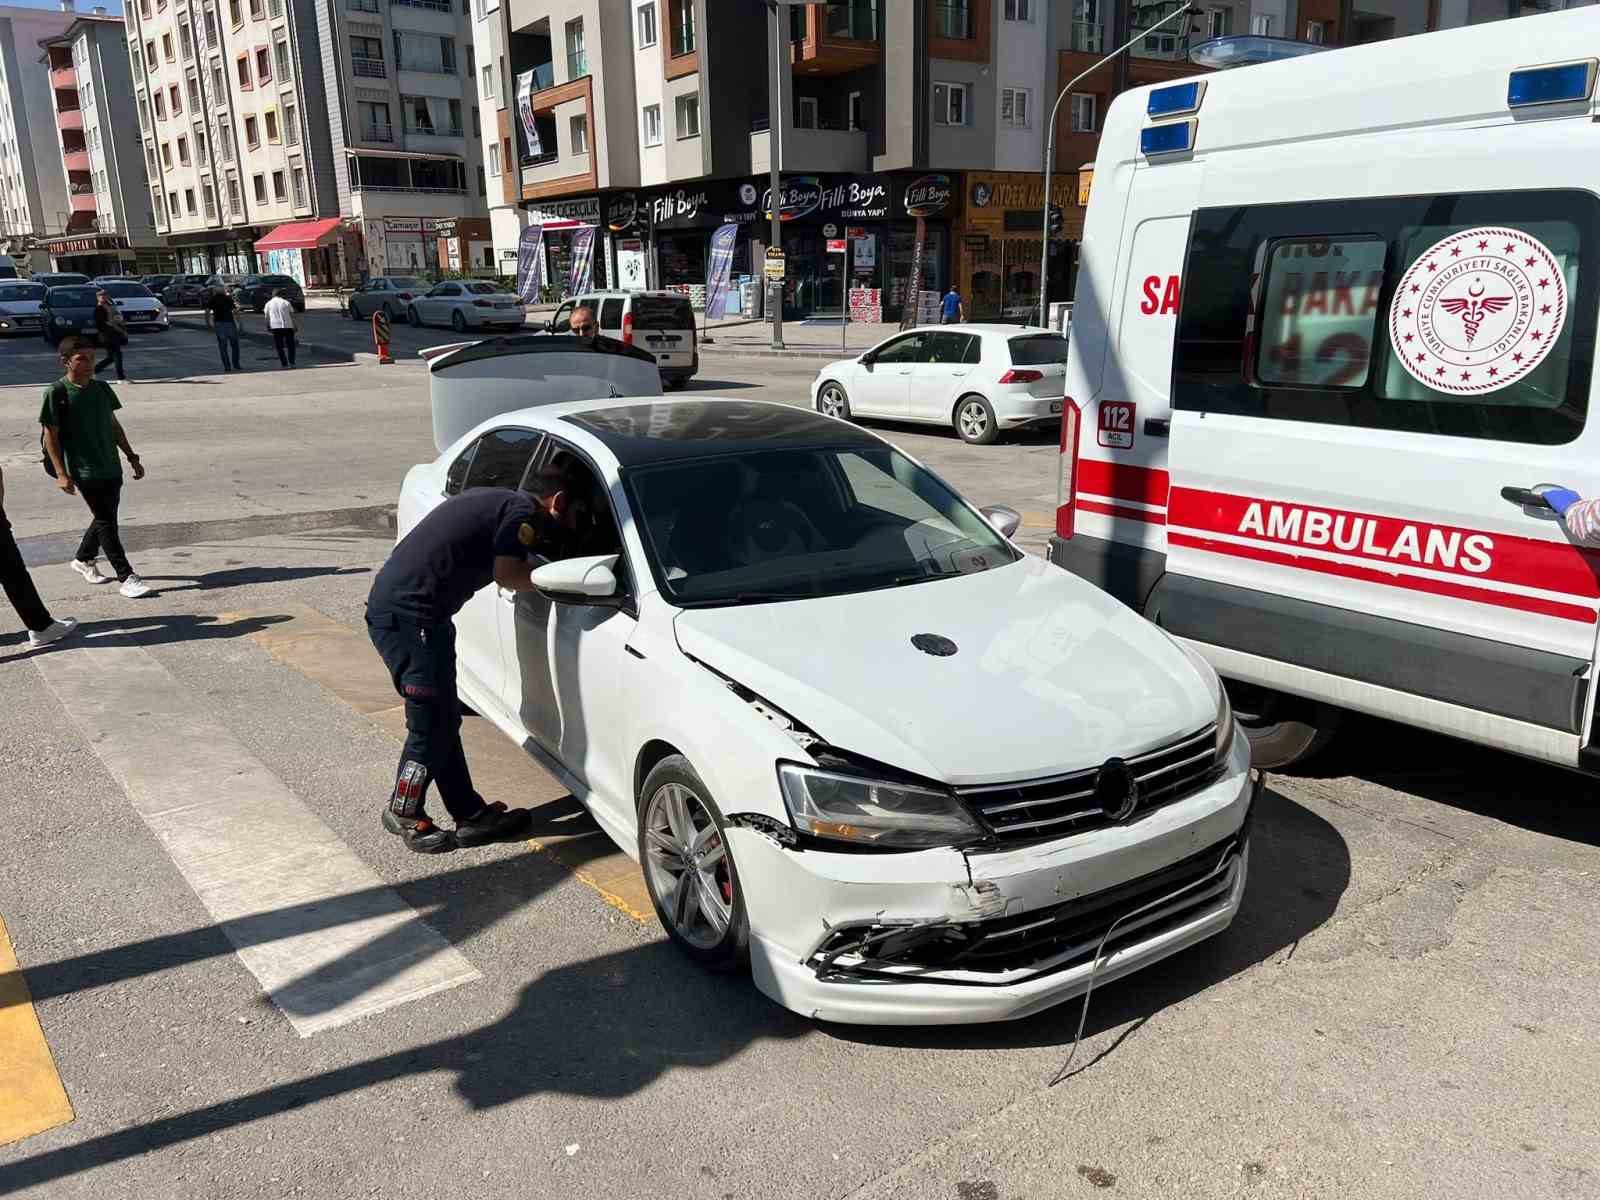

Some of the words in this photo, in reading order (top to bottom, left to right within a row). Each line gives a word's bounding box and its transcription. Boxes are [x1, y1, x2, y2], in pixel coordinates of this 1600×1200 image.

[653, 196, 678, 225] Filli
[677, 189, 708, 219] Boya
[789, 189, 818, 206] Boya
[821, 185, 846, 211] Filli
[848, 183, 885, 207] Boya
[910, 186, 927, 203] Filli
[868, 209, 885, 217] YAPI
[1423, 258, 1491, 309] CUMHURİYETİ
[1493, 261, 1528, 291] SAĞLIK
[1493, 294, 1529, 355] BAKANLIĞI
[1103, 405, 1130, 429] 112
[1237, 502, 1495, 574] AMBULANS
